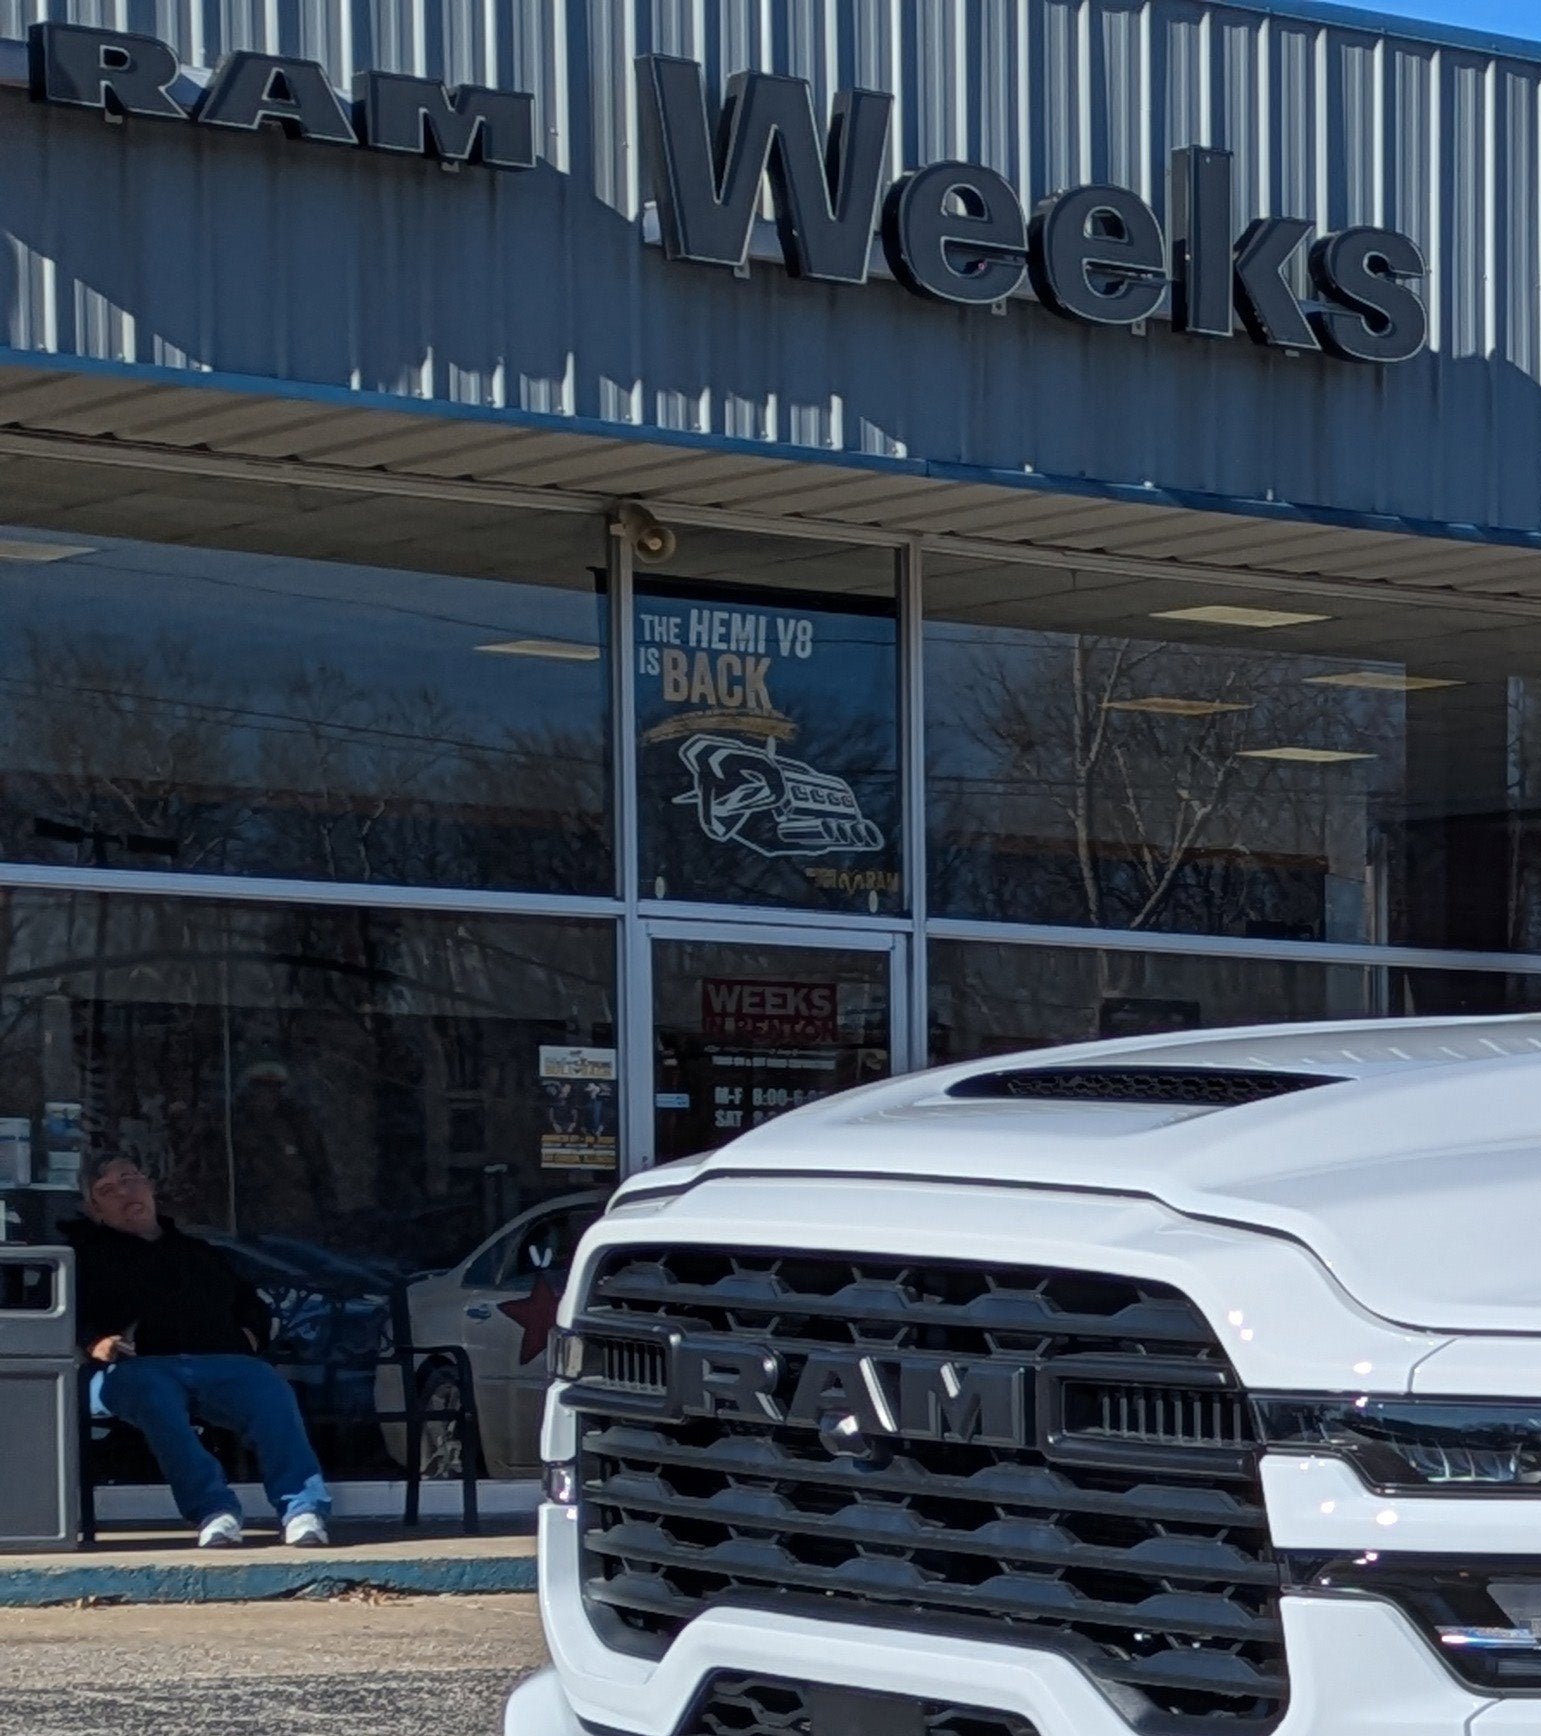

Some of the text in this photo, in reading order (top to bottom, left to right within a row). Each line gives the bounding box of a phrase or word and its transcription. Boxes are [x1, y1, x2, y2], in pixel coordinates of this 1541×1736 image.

[28, 21, 537, 170] RAM
[634, 53, 1429, 364] Weeks
[639, 608, 813, 658] THE HEMI V8
[639, 646, 771, 713] IS BACK
[708, 984, 832, 1017] WEEKS
[681, 1342, 1030, 1446] RAM
